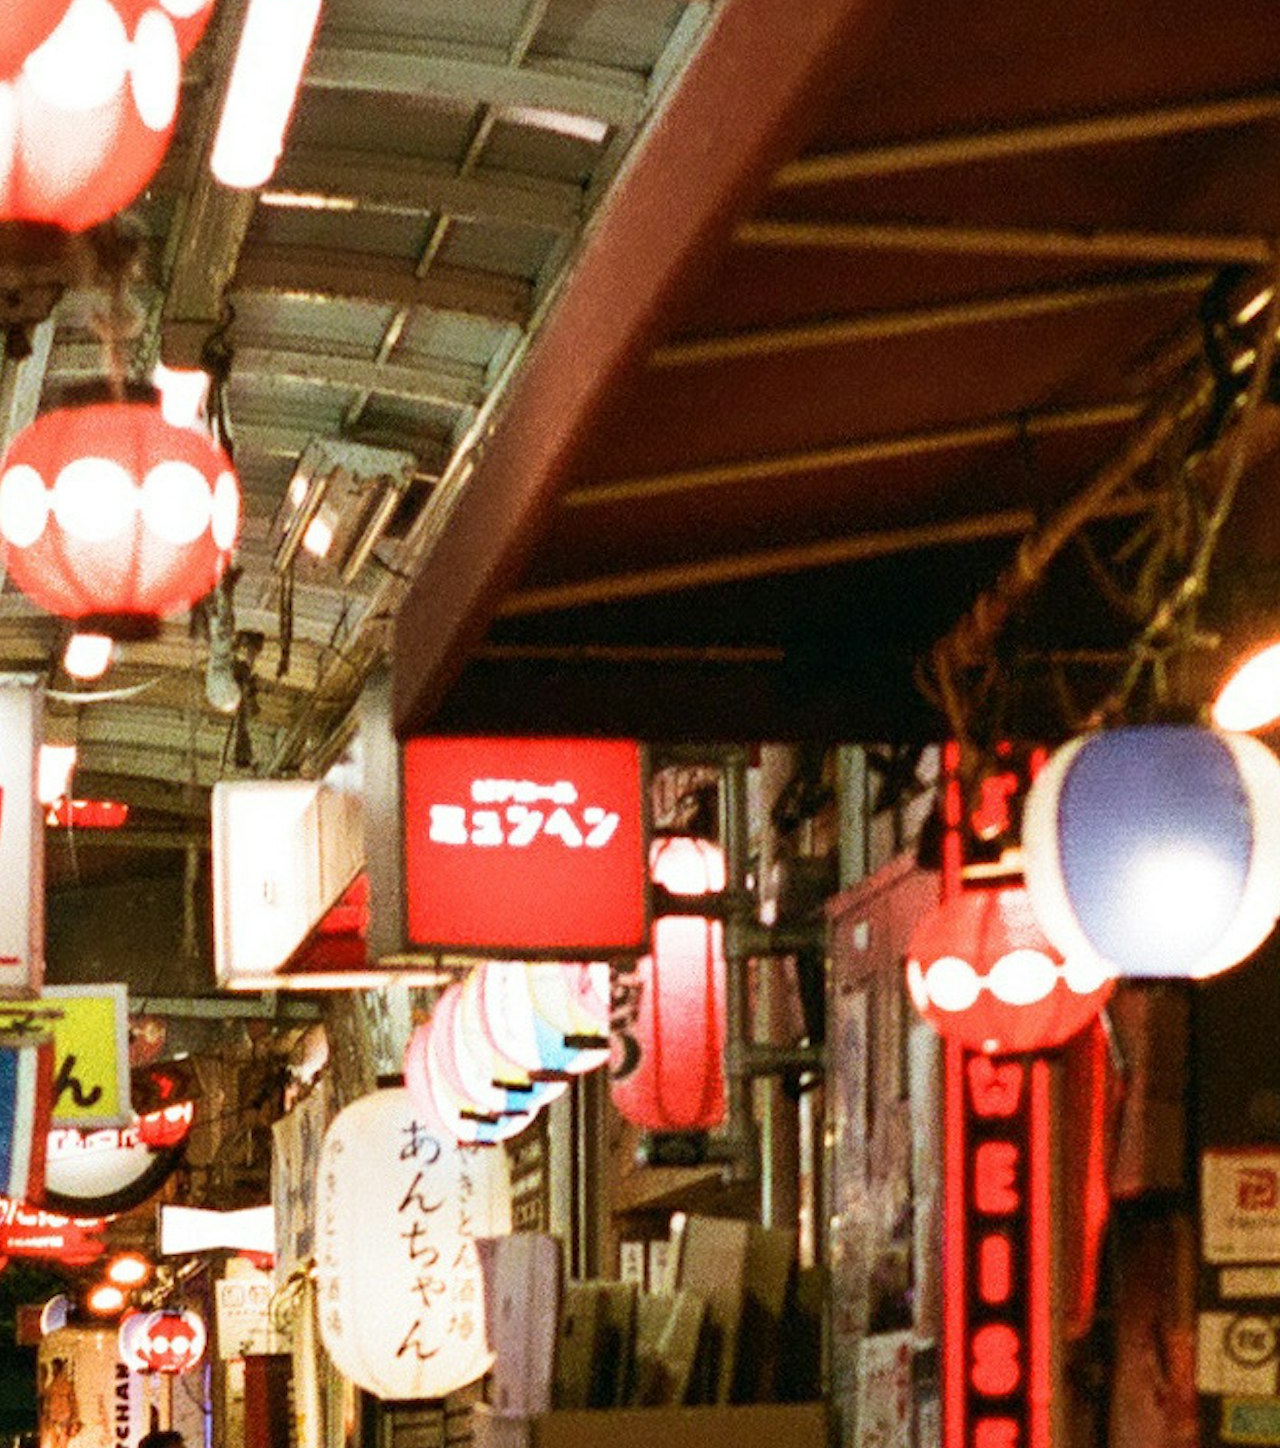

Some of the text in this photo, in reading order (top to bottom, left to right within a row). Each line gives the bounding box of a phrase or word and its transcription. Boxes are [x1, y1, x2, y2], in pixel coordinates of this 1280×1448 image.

[396, 1120, 446, 1361] あんちゃん
